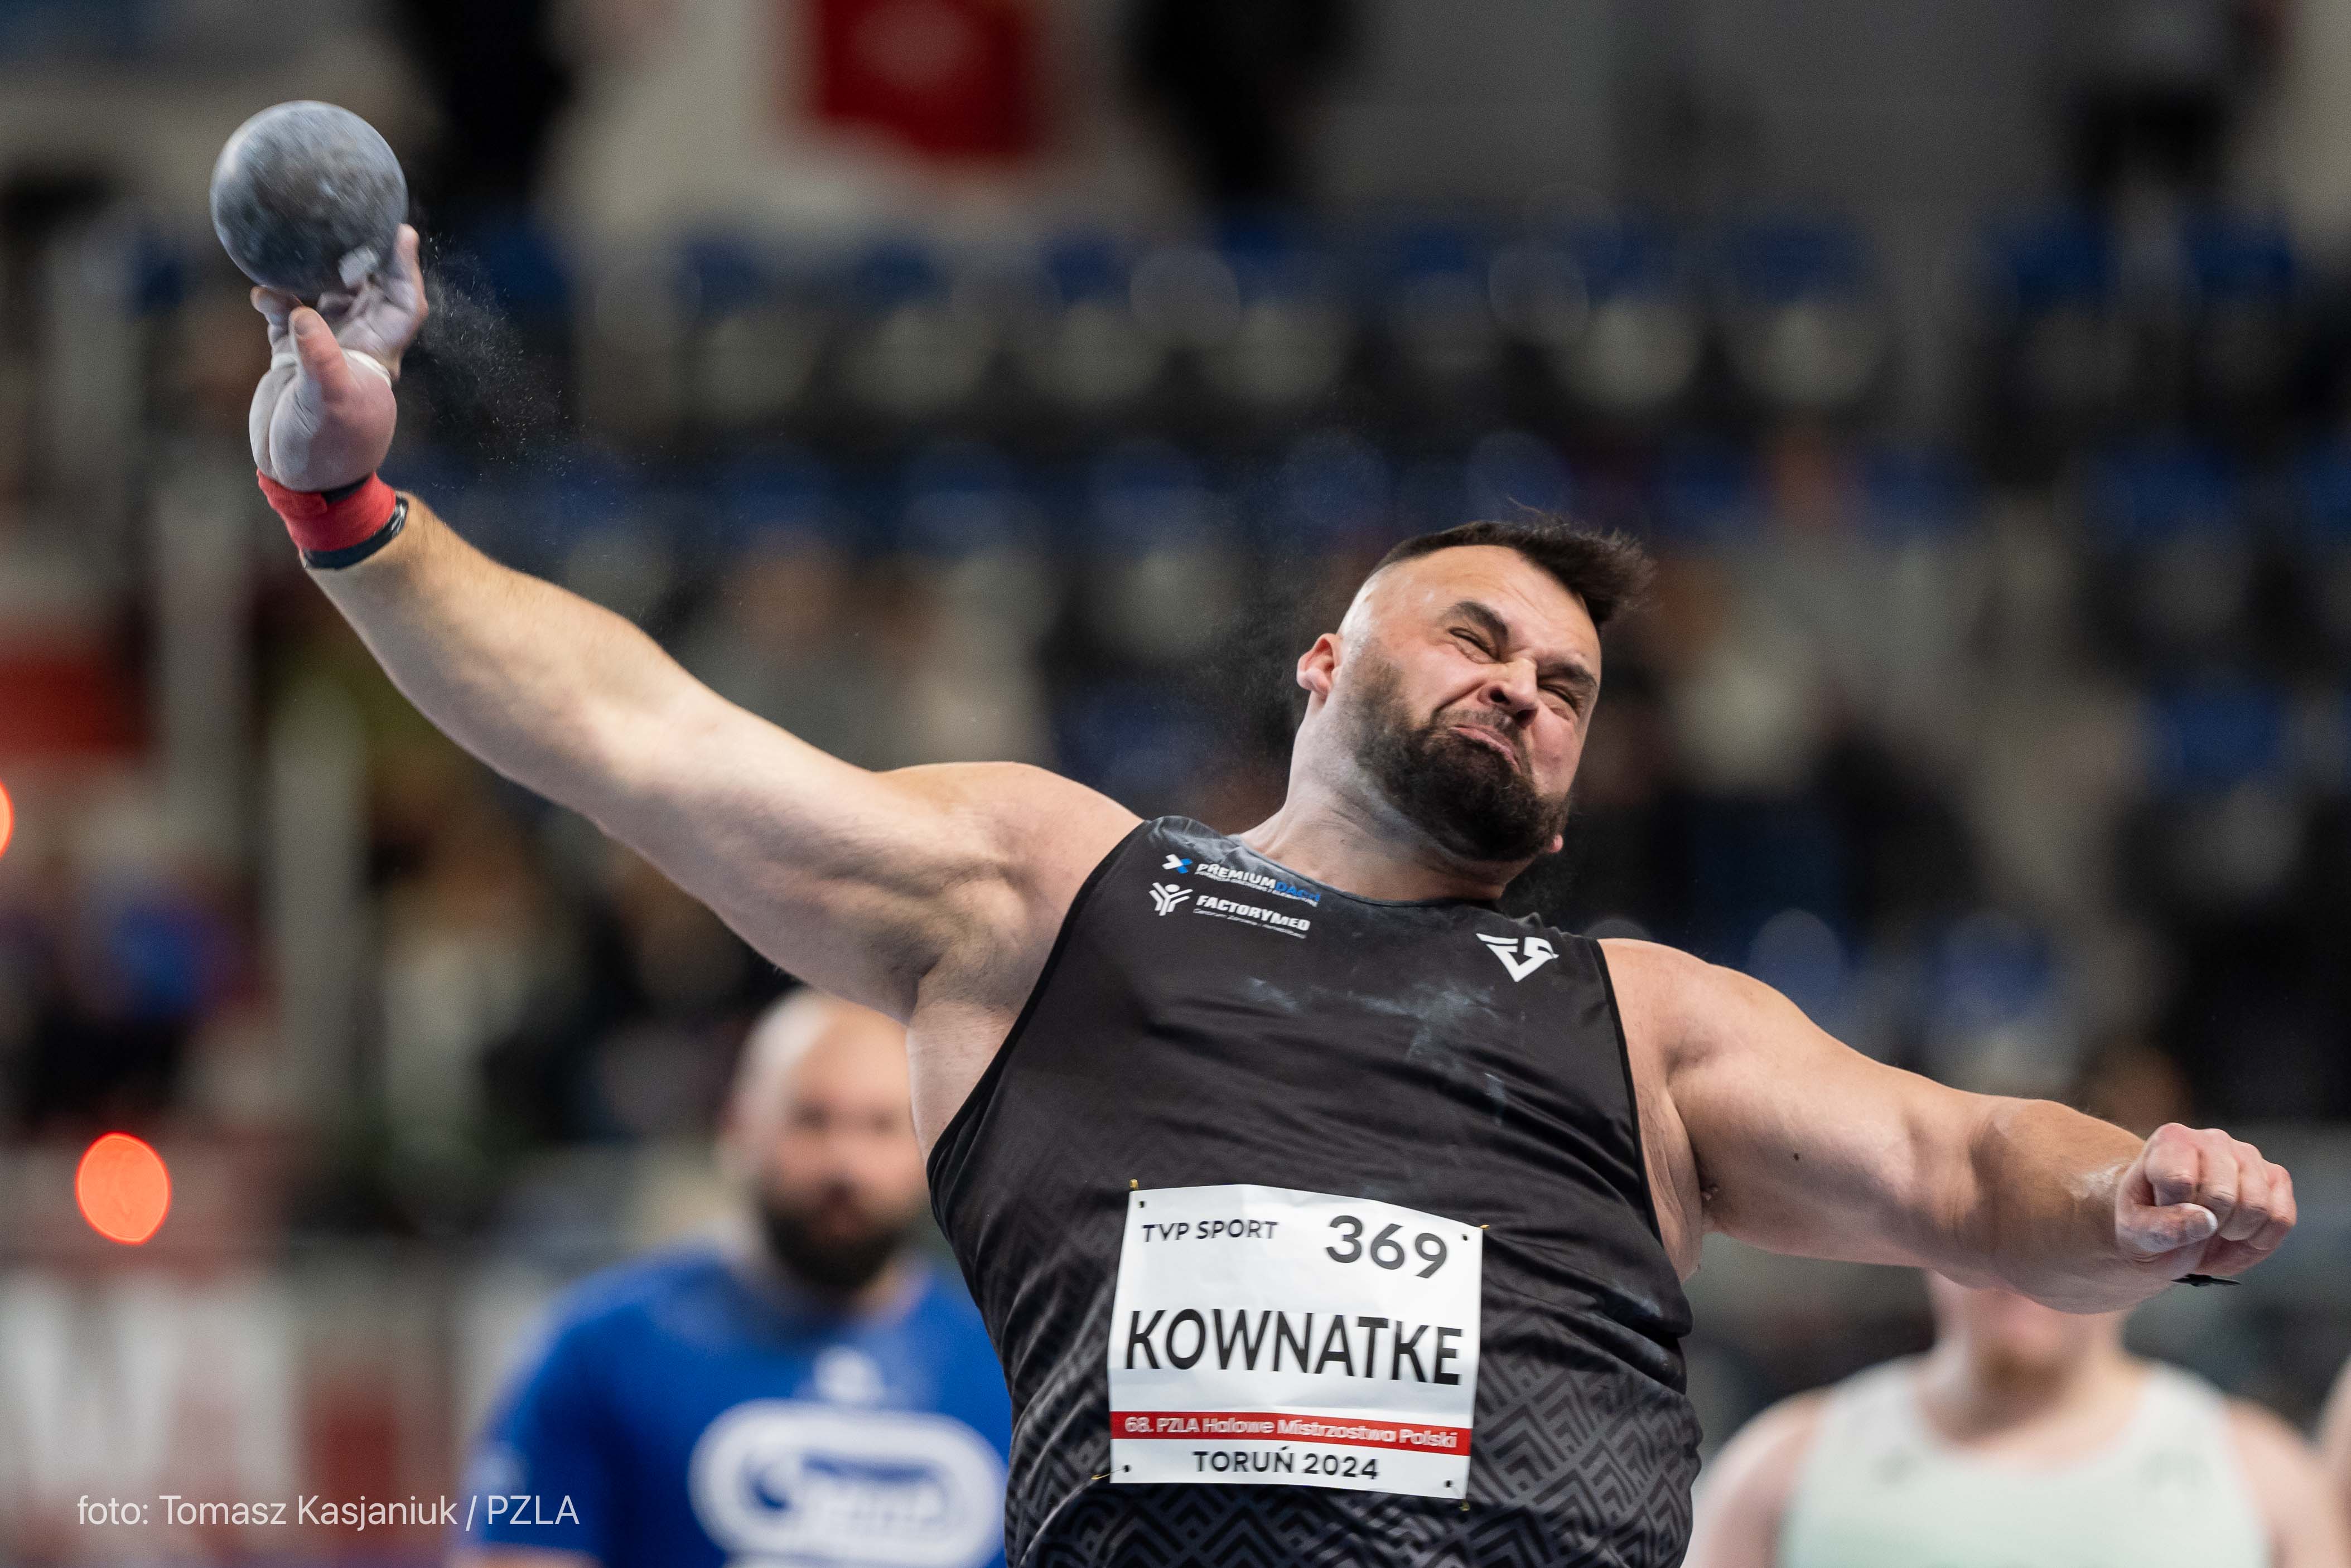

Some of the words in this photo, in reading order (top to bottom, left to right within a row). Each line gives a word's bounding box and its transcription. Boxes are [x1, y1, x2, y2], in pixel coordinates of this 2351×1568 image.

[1196, 895, 1310, 931] FACTORYMED
[1142, 1222, 1189, 1242] TVP
[1197, 1219, 1278, 1239] SPORT
[1326, 1215, 1447, 1278] 369
[1126, 1308, 1463, 1386] KOWNATKE
[1124, 1416, 1154, 1433] 68.
[1157, 1418, 1200, 1433] PZLA
[1399, 1429, 1458, 1448] Polski
[1193, 1446, 1294, 1473] TORUŃ
[1304, 1453, 1380, 1479] 2024
